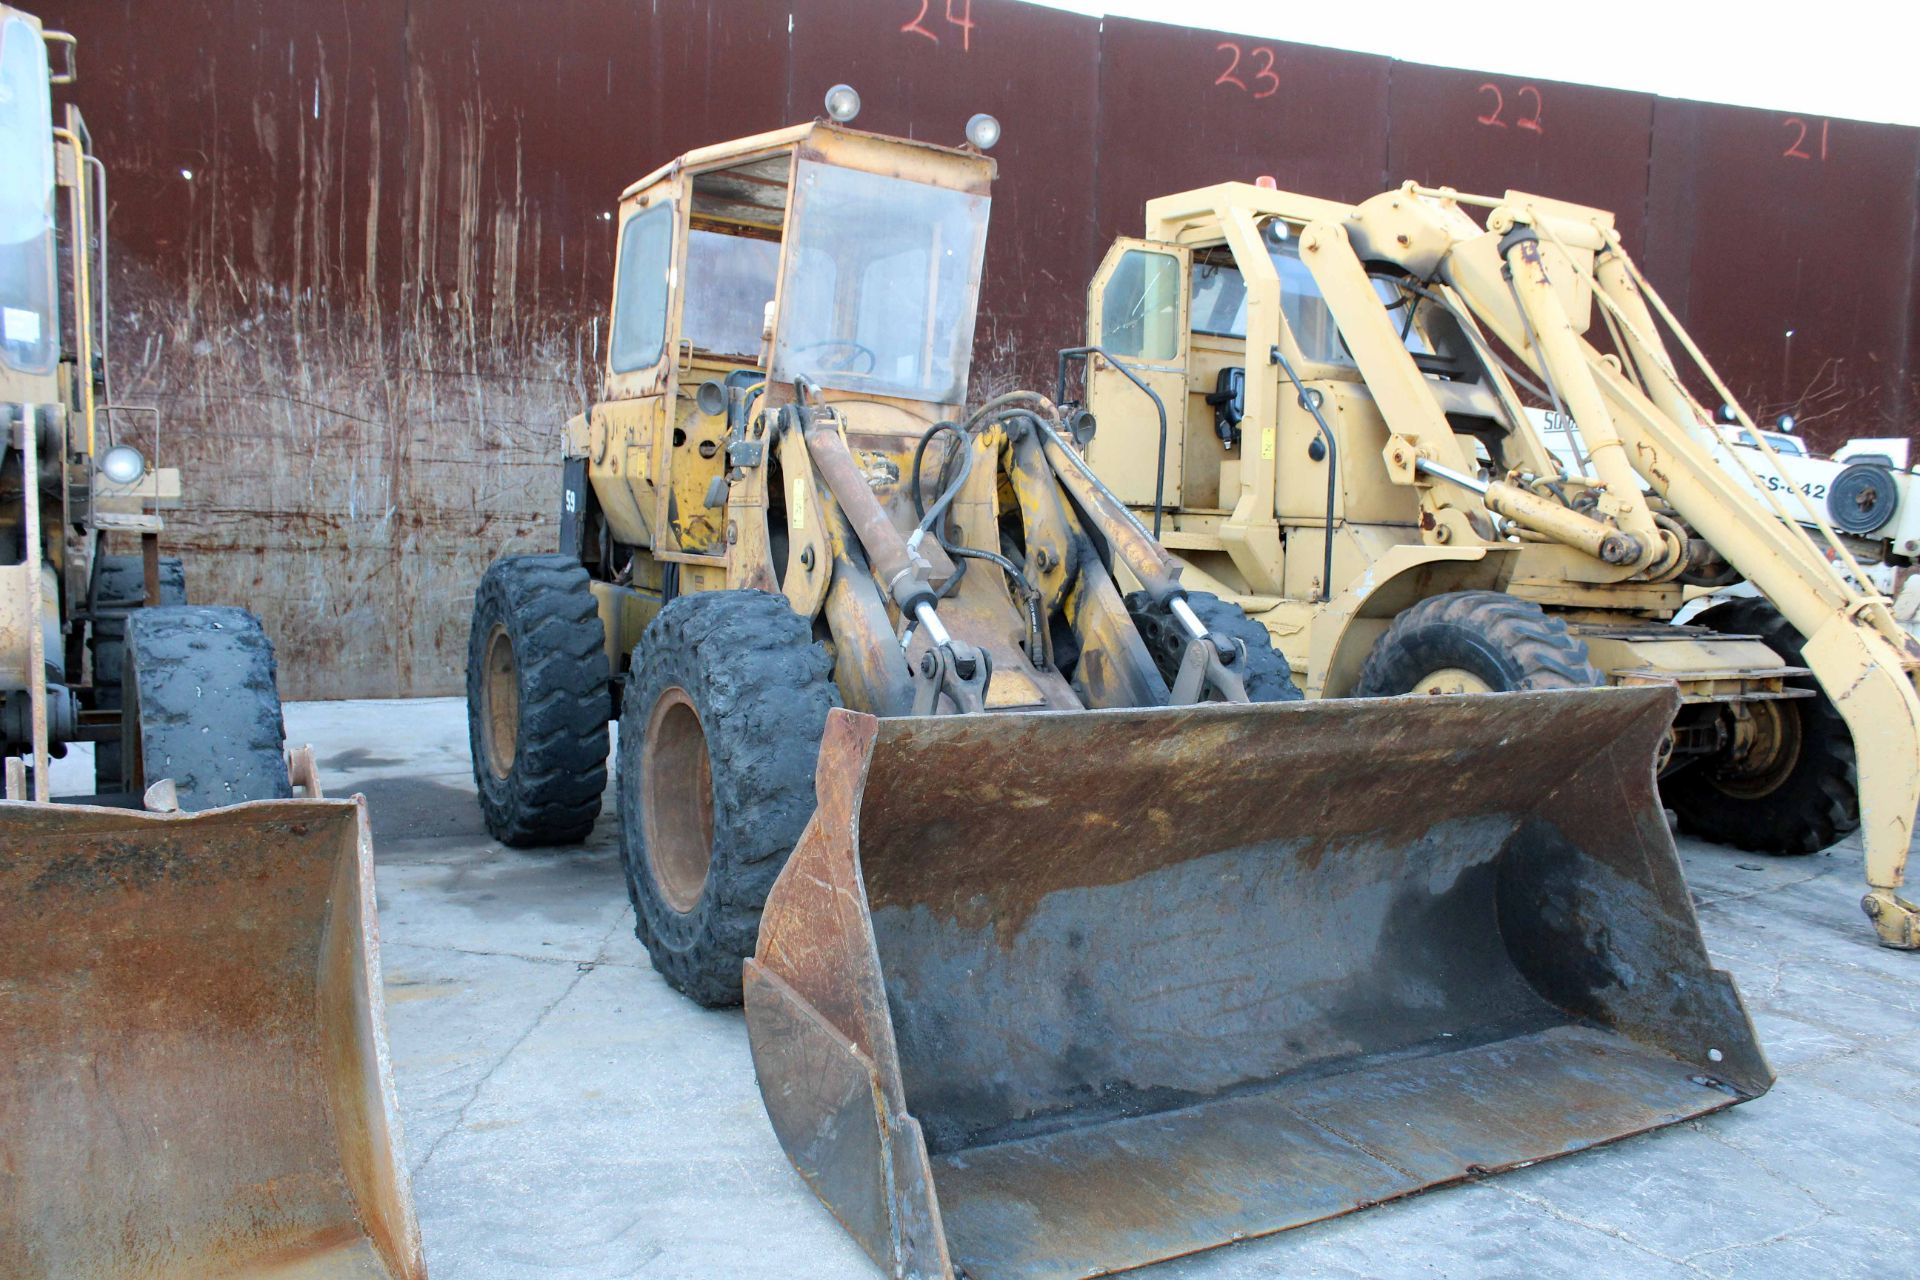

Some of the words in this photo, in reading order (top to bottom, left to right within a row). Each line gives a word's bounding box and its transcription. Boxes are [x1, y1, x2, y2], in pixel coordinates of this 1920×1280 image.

[900, 0, 975, 53] 24
[1215, 42, 1279, 98] 23
[1477, 83, 1543, 134] 22
[1783, 117, 1828, 160] 21
[565, 489, 575, 512] 59
